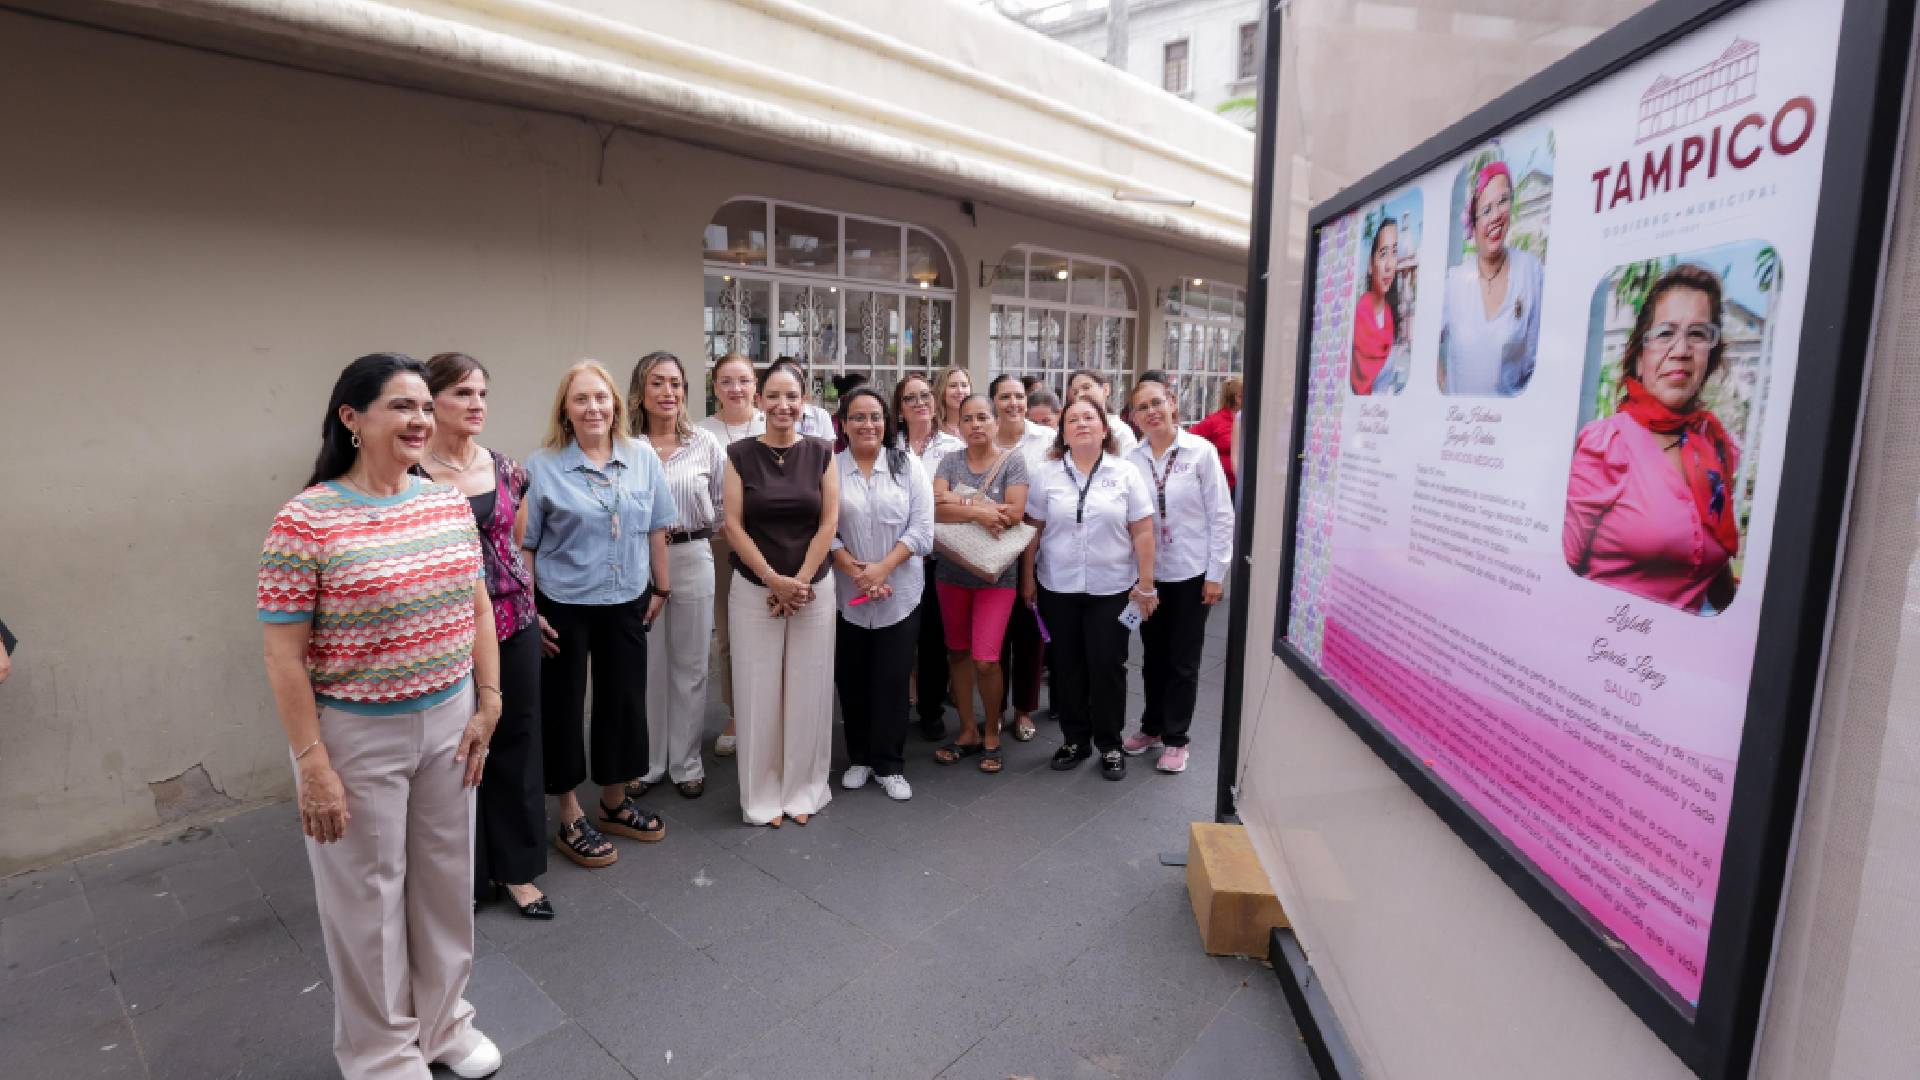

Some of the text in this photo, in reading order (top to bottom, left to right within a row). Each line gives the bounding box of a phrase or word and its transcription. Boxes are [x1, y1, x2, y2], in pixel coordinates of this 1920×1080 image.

[1592, 96, 1816, 213] TAMPICO
[1685, 184, 1778, 216] MUNICIPAL
[1604, 679, 1641, 706] SALUD
[1680, 797, 1687, 810] y
[1689, 802, 1715, 824] cada
[1679, 860, 1695, 880] luz
[1696, 875, 1703, 889] y
[1686, 914, 1698, 930] un
[1645, 926, 1664, 948] que
[1677, 953, 1698, 977] vida
